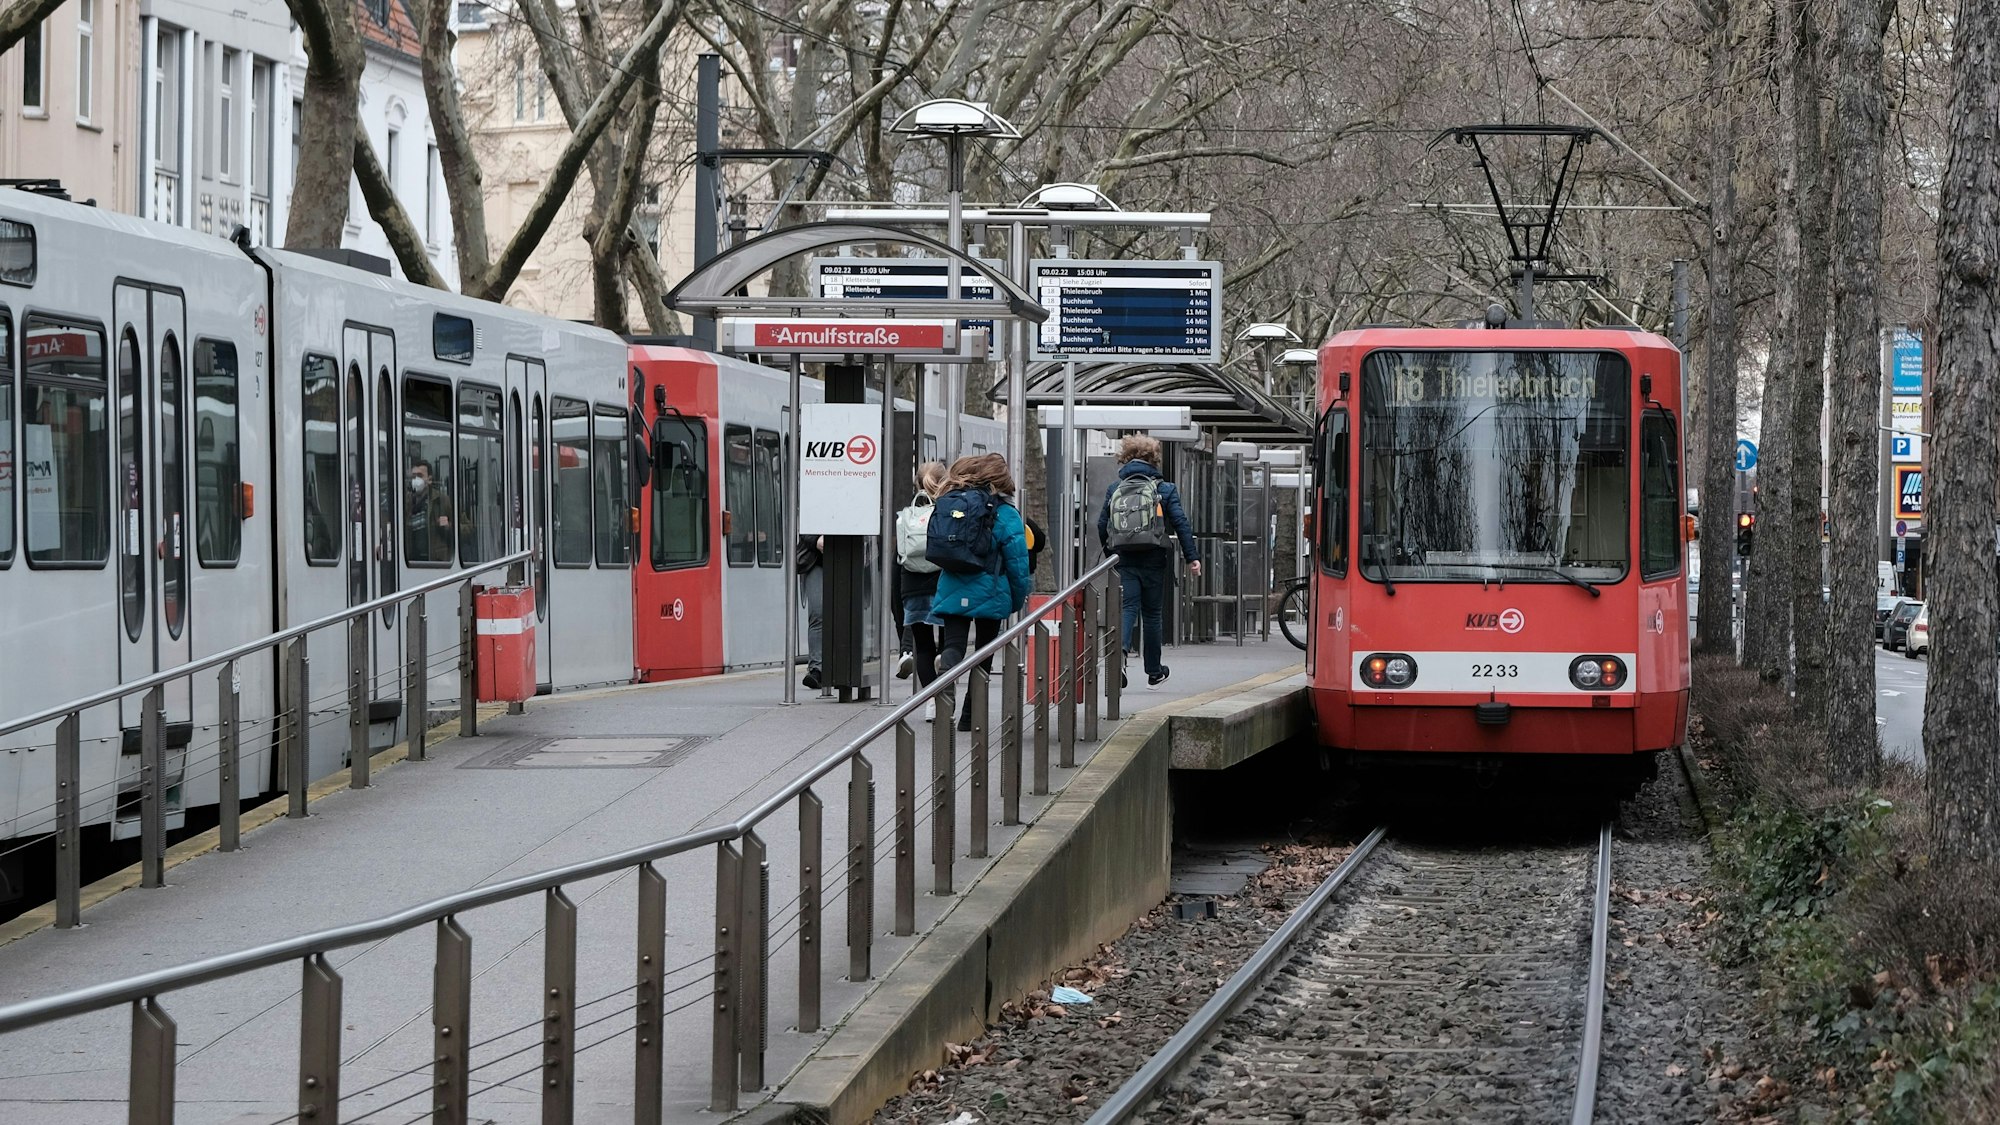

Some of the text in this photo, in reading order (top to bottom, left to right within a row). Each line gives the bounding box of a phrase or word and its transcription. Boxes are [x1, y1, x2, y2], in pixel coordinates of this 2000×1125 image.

[1081, 278, 1102, 286] Zugziel
[777, 327, 899, 344] Arnulfstraße
[1396, 366, 1595, 401] 18 Thielenbruch
[806, 442, 845, 458] KVB
[1897, 440, 1906, 453] P
[843, 470, 876, 478] bewegen
[661, 604, 674, 617] KVB
[1466, 614, 1499, 627] KVB
[1472, 665, 1519, 678] 2233
